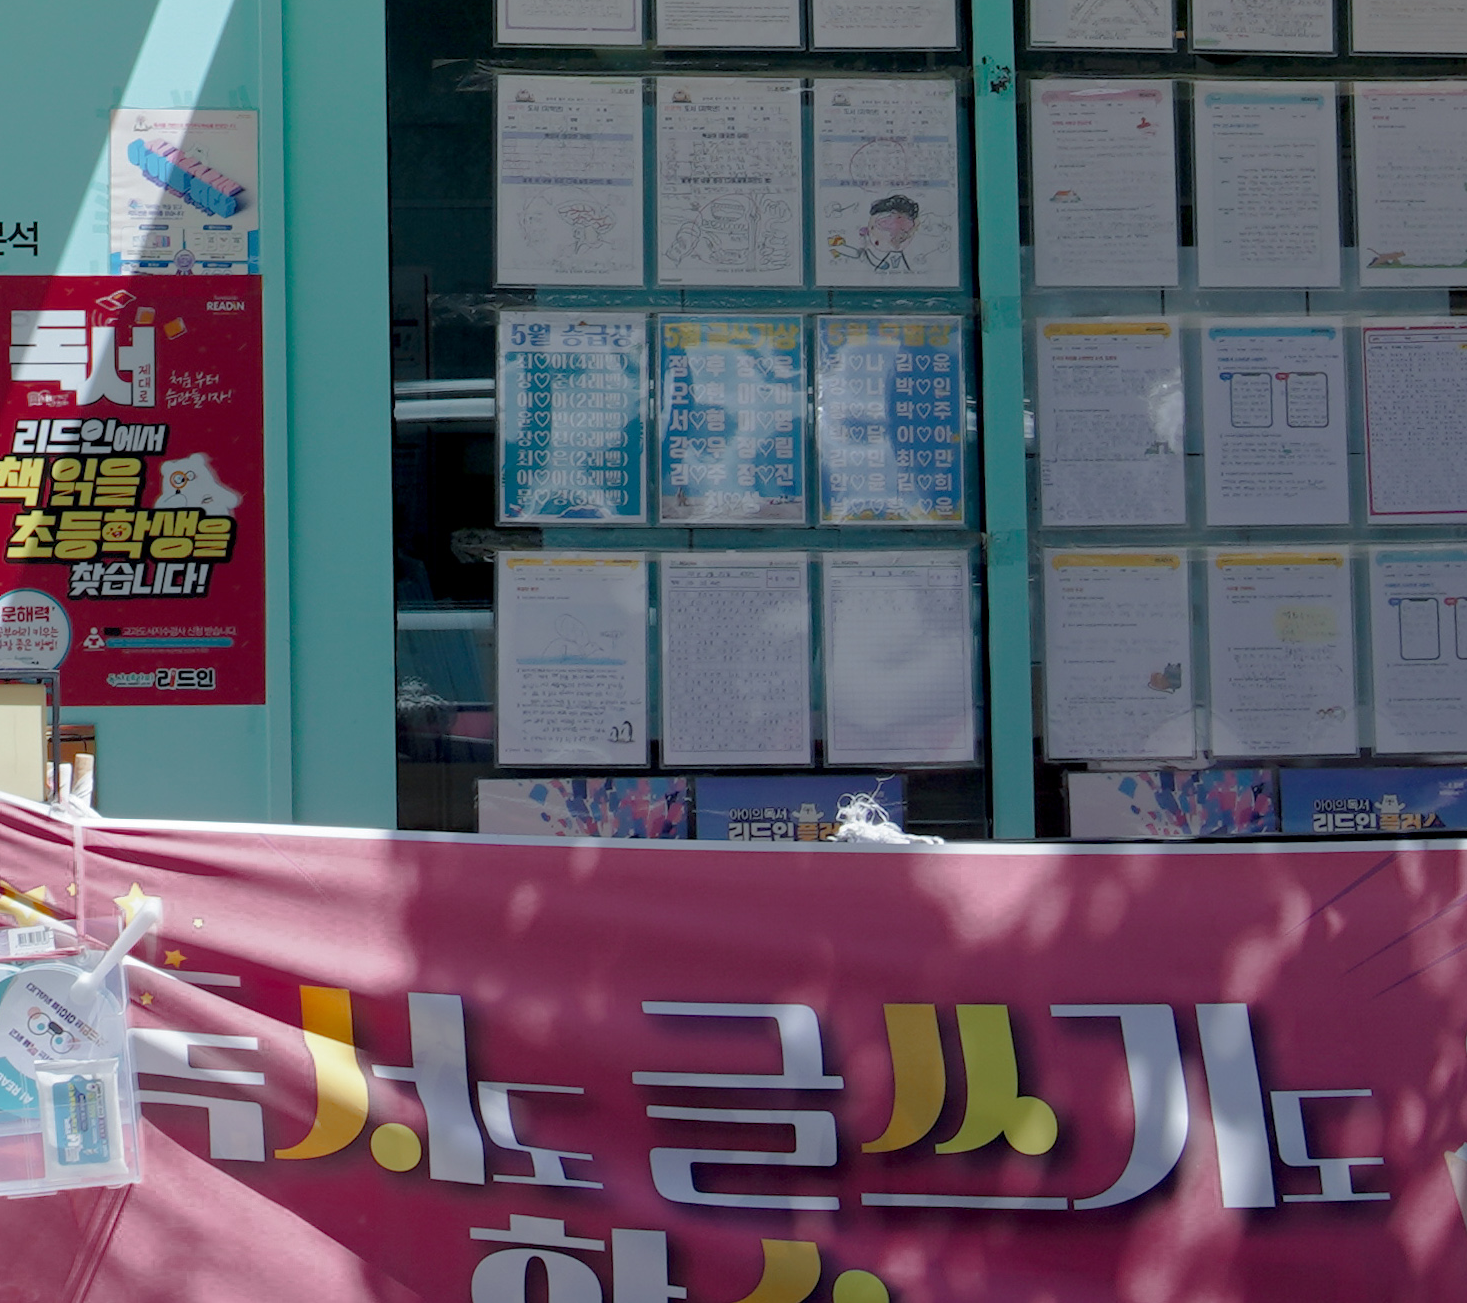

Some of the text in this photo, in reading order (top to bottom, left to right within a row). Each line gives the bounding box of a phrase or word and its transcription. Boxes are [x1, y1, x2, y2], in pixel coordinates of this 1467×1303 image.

[511, 323, 551, 346] 5월
[9, 310, 156, 407] 독서
[138, 364, 152, 403] 제대로
[12, 420, 165, 453] 리드인에서
[50, 457, 141, 506] 읽을
[7, 510, 232, 560] 초등학생을
[70, 563, 209, 596] 찾습니다!
[157, 669, 215, 690] 리드인
[632, 999, 1391, 1211] 글쓰기도
